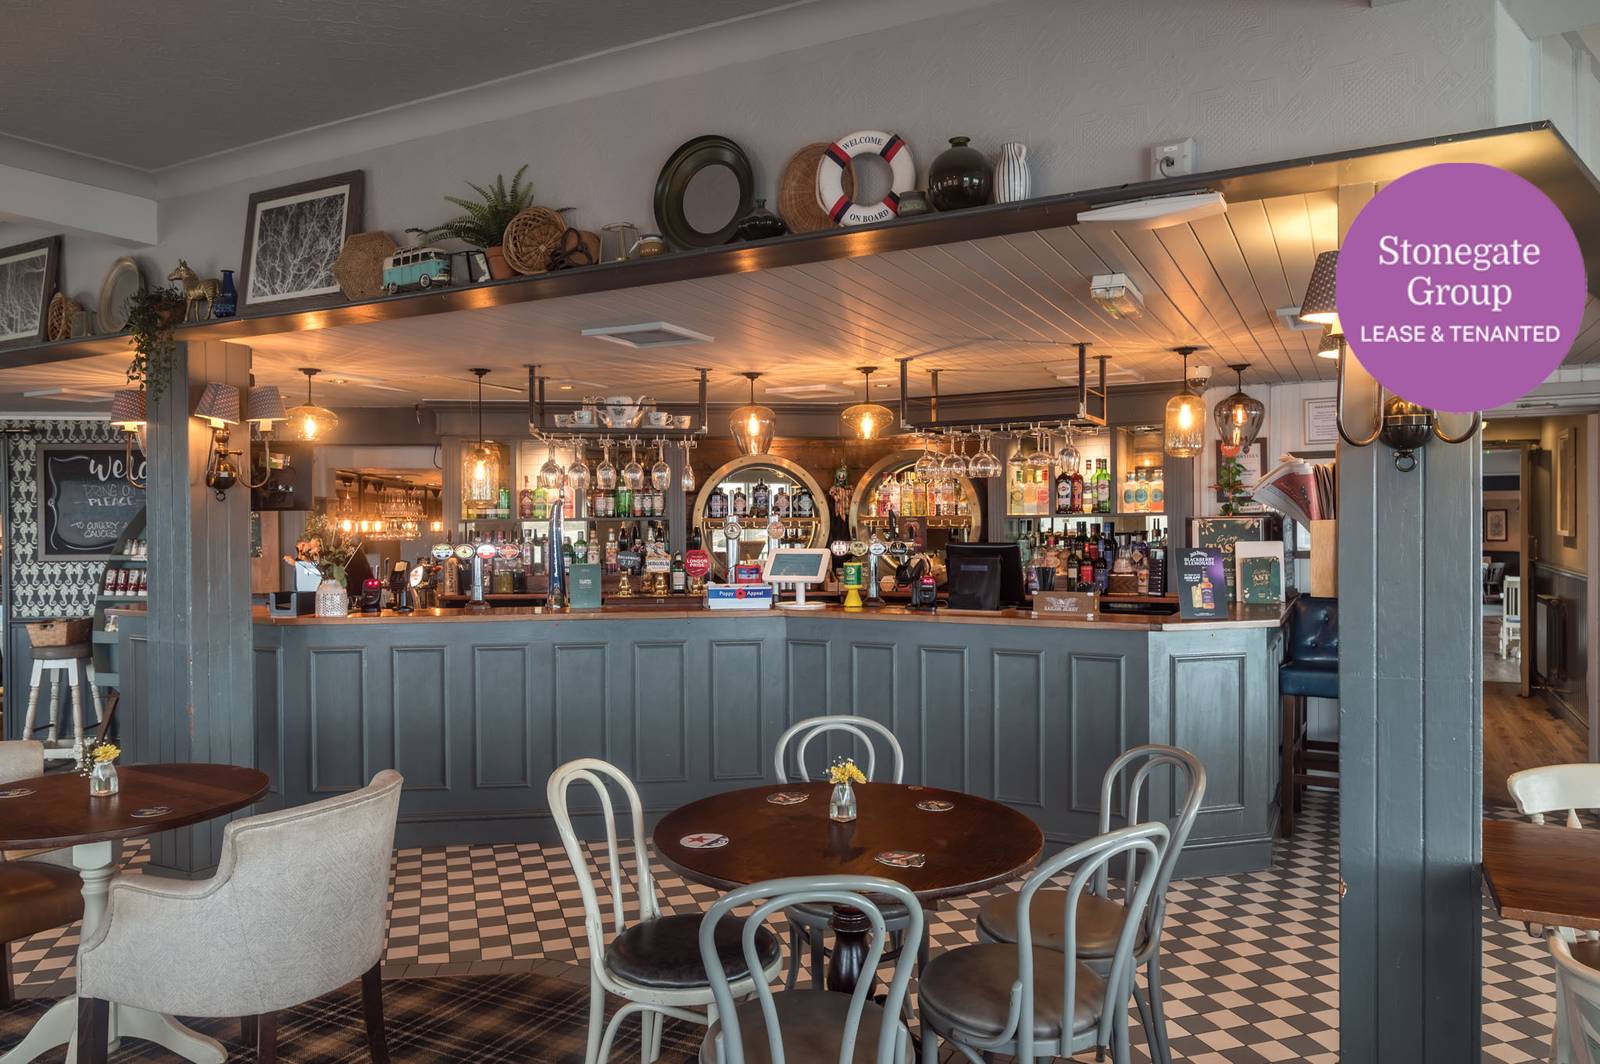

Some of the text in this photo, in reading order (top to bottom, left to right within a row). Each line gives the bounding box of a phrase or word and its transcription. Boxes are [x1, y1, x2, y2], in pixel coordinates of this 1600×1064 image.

[842, 136, 883, 150] WELCOME
[850, 209, 889, 223] ON BOARD
[89, 456, 147, 482] Welc
